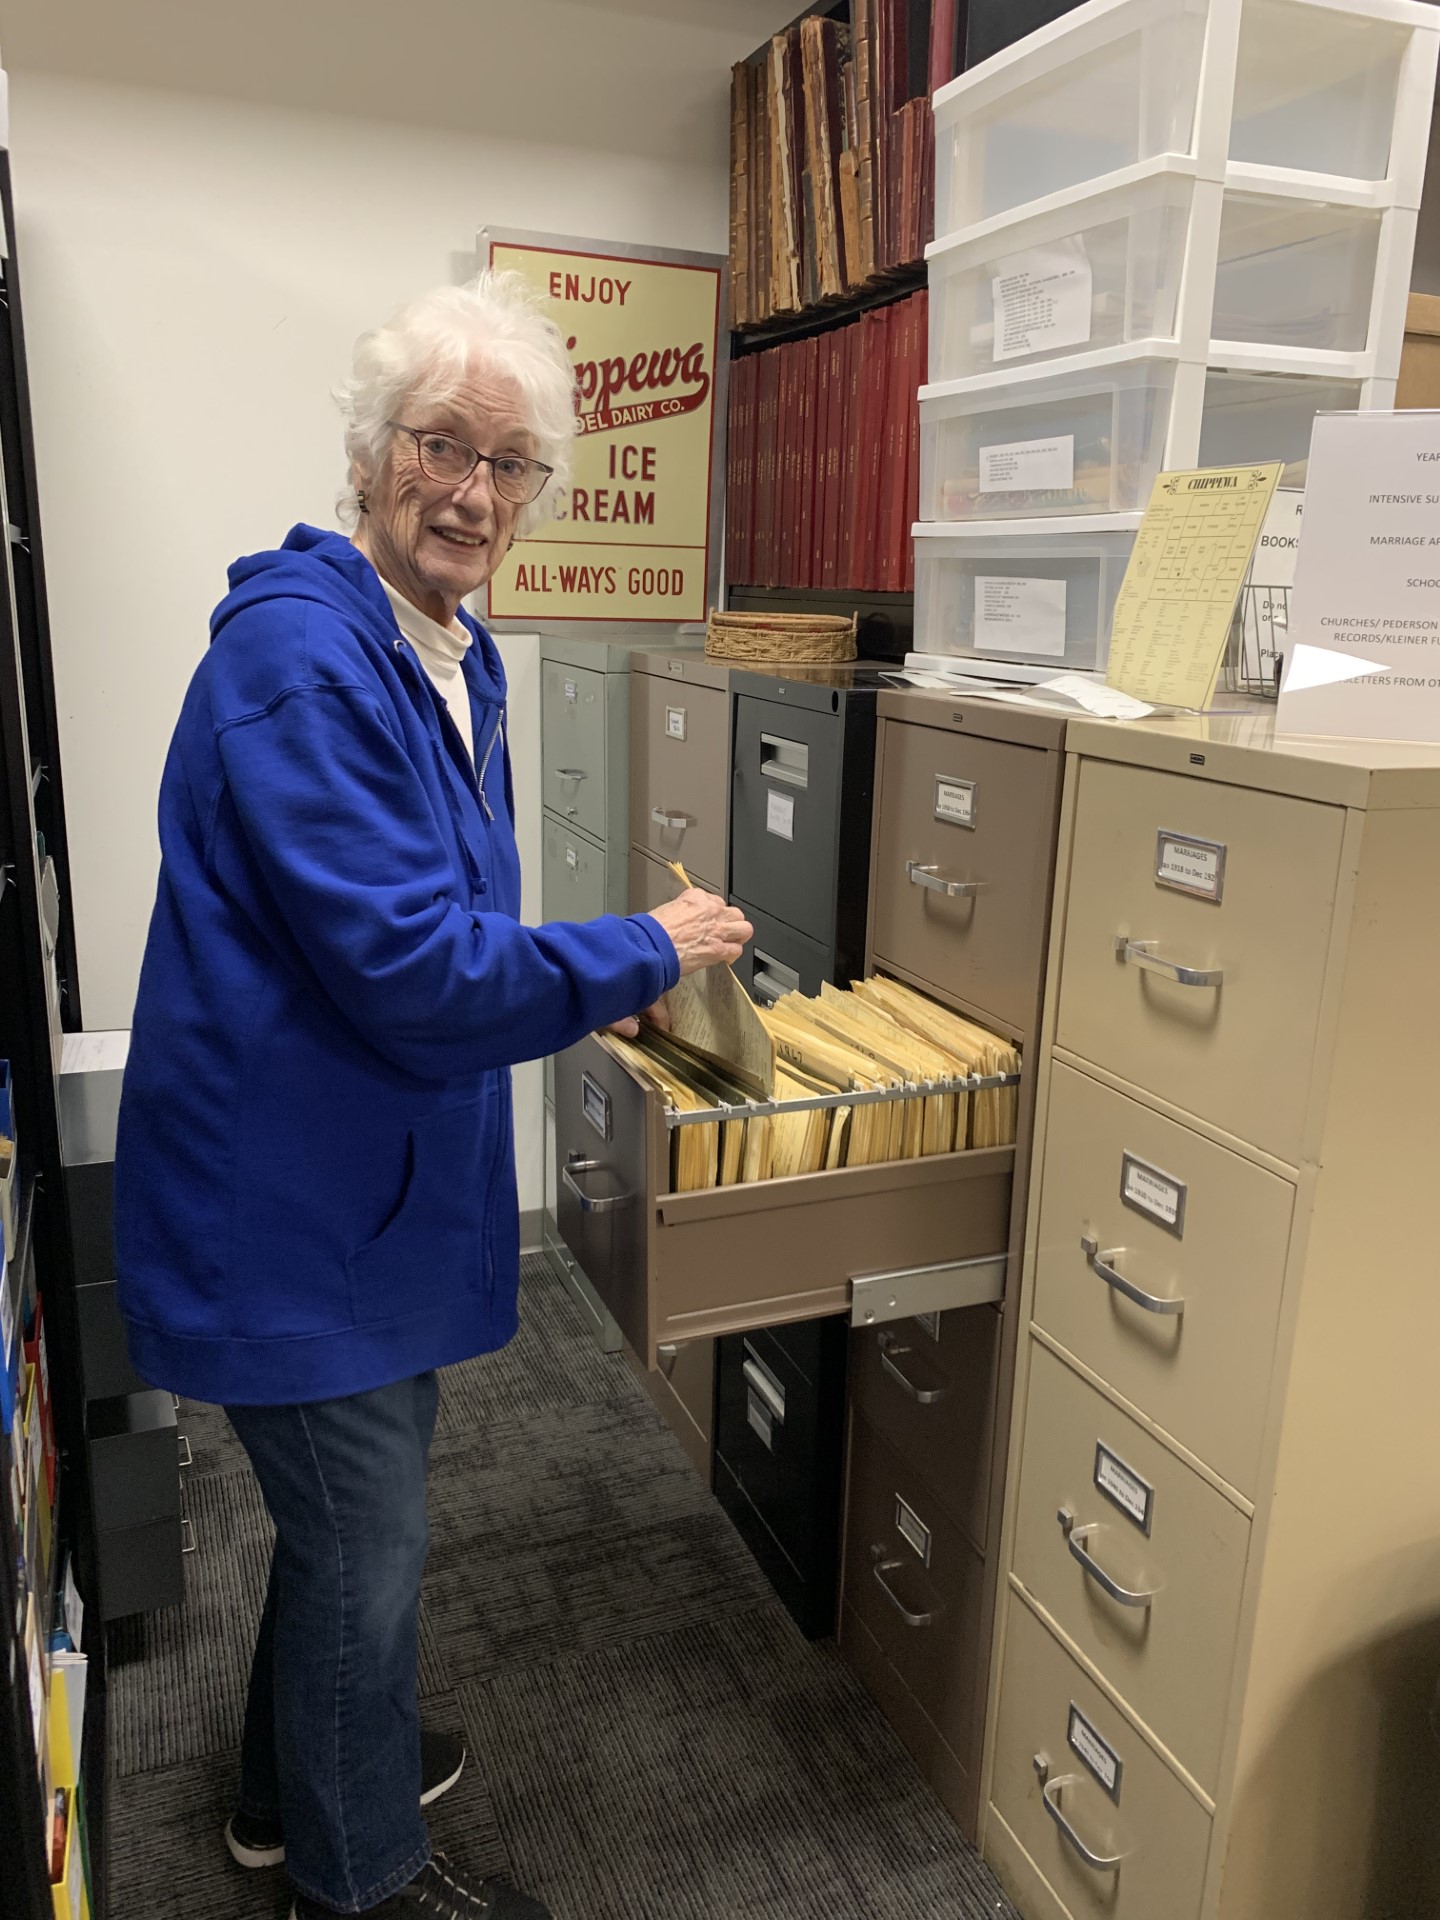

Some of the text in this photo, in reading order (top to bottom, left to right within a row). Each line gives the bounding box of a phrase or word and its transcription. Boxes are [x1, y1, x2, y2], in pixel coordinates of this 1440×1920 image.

[549, 271, 632, 306] ENJOY
[575, 399, 686, 434] DEL DAIRY CO.
[609, 444, 657, 482] ICE
[1187, 476, 1238, 490] CHIPPEWA
[552, 486, 655, 525] CREAM
[1369, 494, 1422, 504] INTENSIVE
[1369, 536, 1426, 546] MARRIAGE
[515, 563, 684, 596] ALL-WAYS GOOD
[1320, 617, 1439, 630] CHURCHES/ PEDERSON
[1333, 632, 1428, 645] RECORDS/KLEINER
[1338, 675, 1391, 686] SLETTERS
[1393, 676, 1425, 687] FROM
[1173, 846, 1208, 862] MARRIAGES
[1192, 868, 1203, 879] Dec
[1204, 872, 1215, 882] 192
